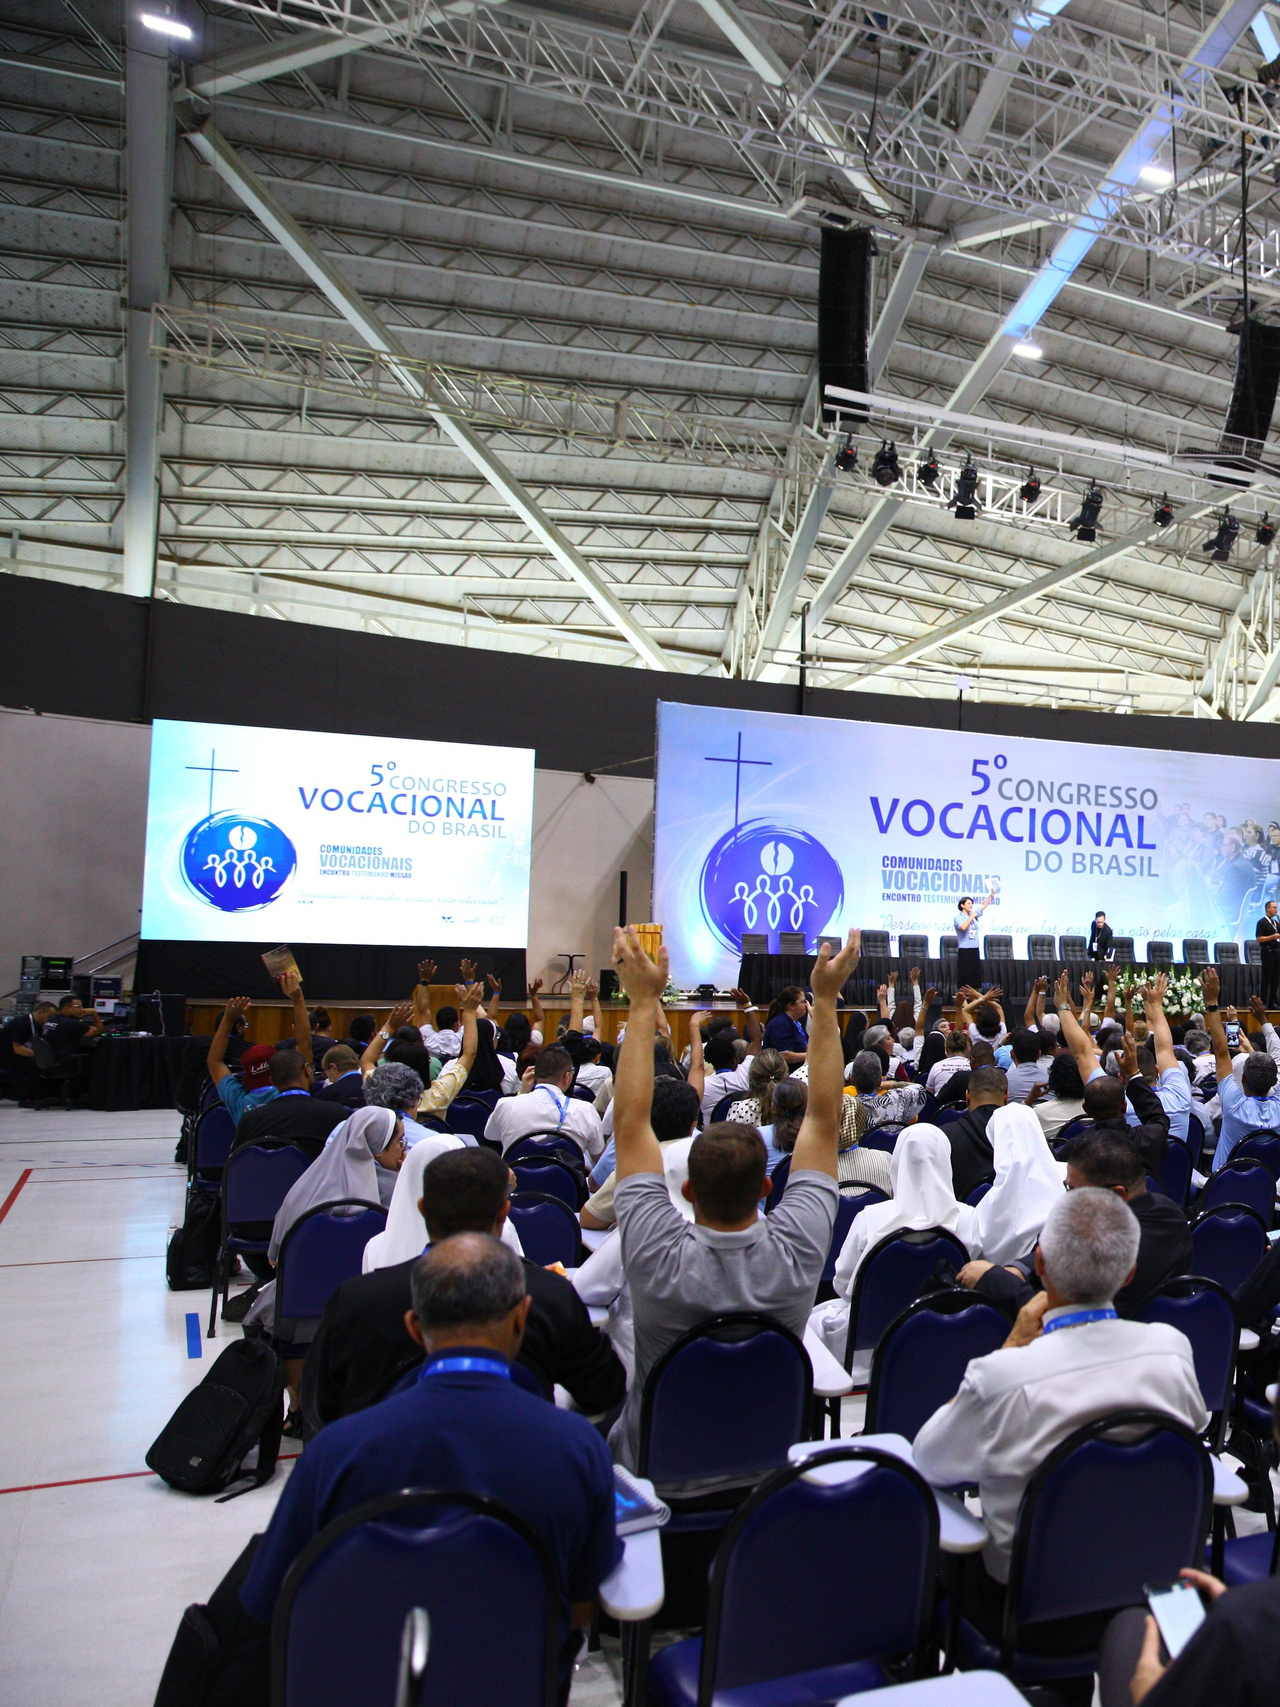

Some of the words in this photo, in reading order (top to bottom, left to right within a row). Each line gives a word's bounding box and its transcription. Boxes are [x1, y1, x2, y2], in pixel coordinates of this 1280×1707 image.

[389, 775, 507, 797] CONGRESSO
[997, 777, 1159, 811] CONGRESSO
[298, 786, 506, 822] VOCACIONAL
[408, 820, 436, 835] DO
[442, 822, 507, 839] BRASIL
[869, 795, 1157, 850] VOCACIONAL
[319, 844, 383, 856] COMUNIDADES
[319, 854, 412, 871] VOCACIONAIS
[881, 855, 963, 872] COMUNIDADES
[1024, 850, 1064, 873] DO
[1071, 853, 1160, 877] BRASIL
[882, 892, 922, 903] ENCONTRO
